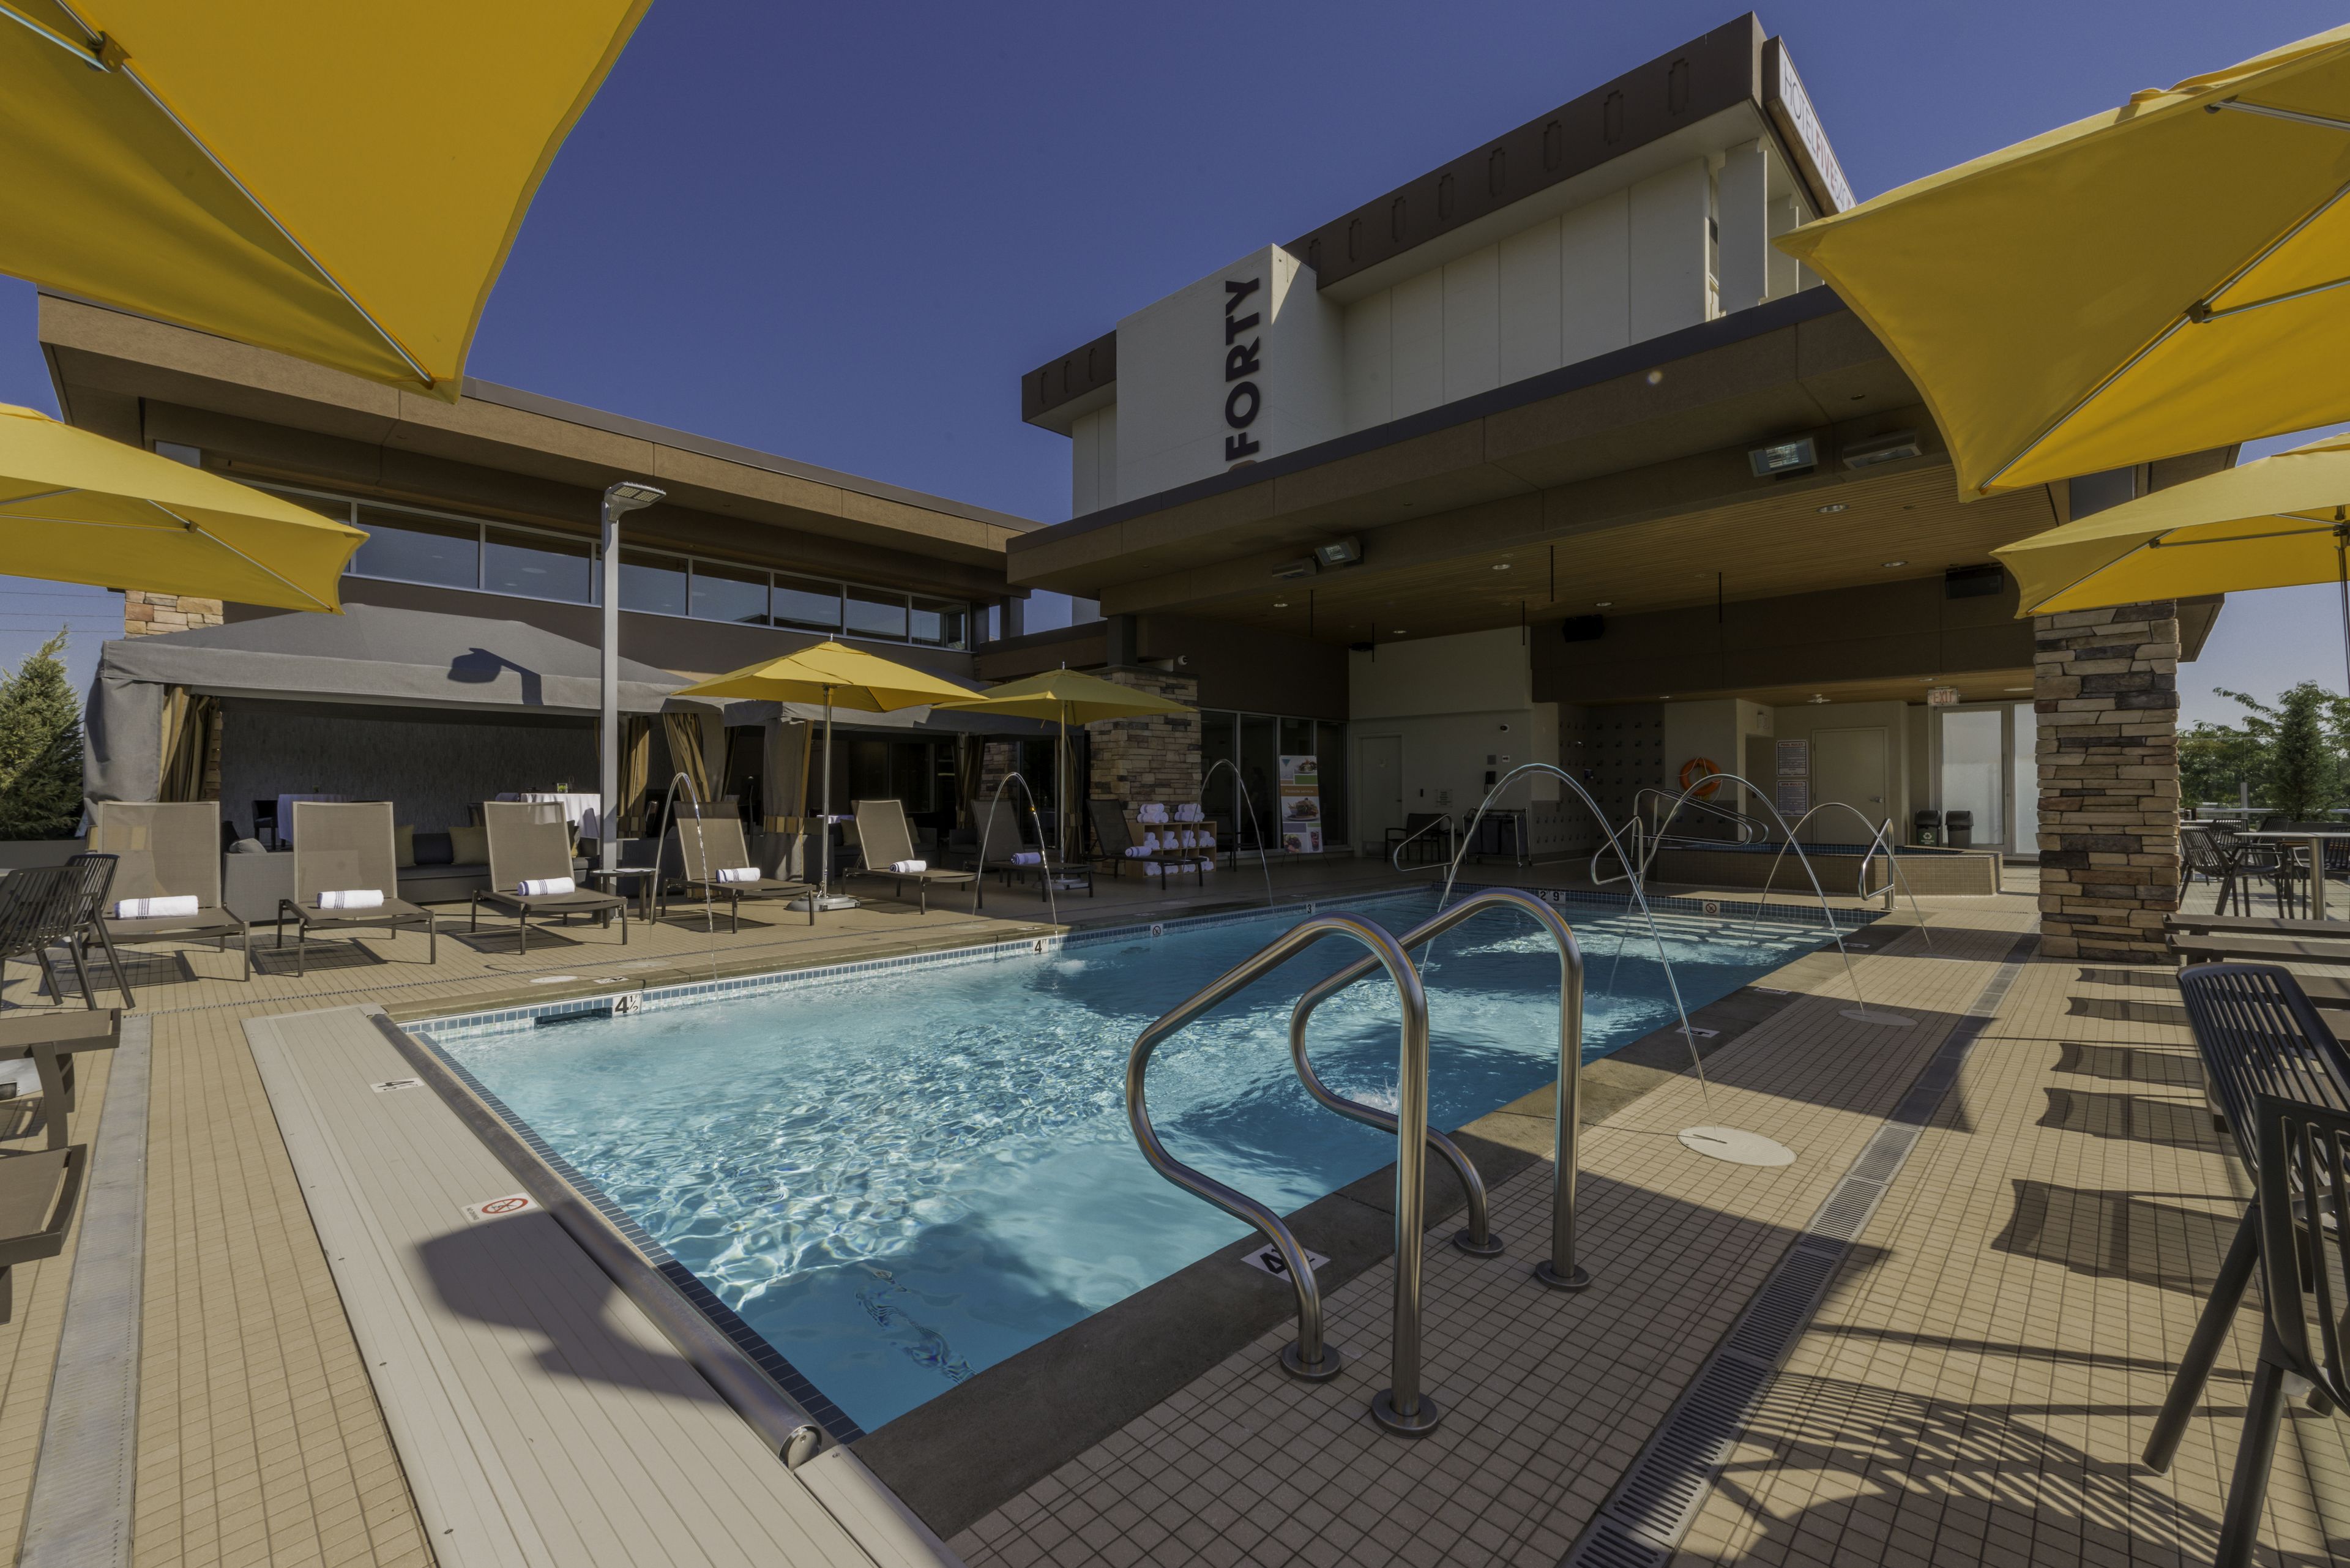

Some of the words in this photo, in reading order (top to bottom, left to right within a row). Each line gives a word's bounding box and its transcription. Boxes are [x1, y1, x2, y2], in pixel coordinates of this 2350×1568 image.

[1225, 277, 1260, 461] FORTY
[1934, 691, 1953, 703] EXIT
[1540, 890, 1546, 900] 2
[1553, 891, 1559, 901] 9
[1034, 939, 1042, 953] 4
